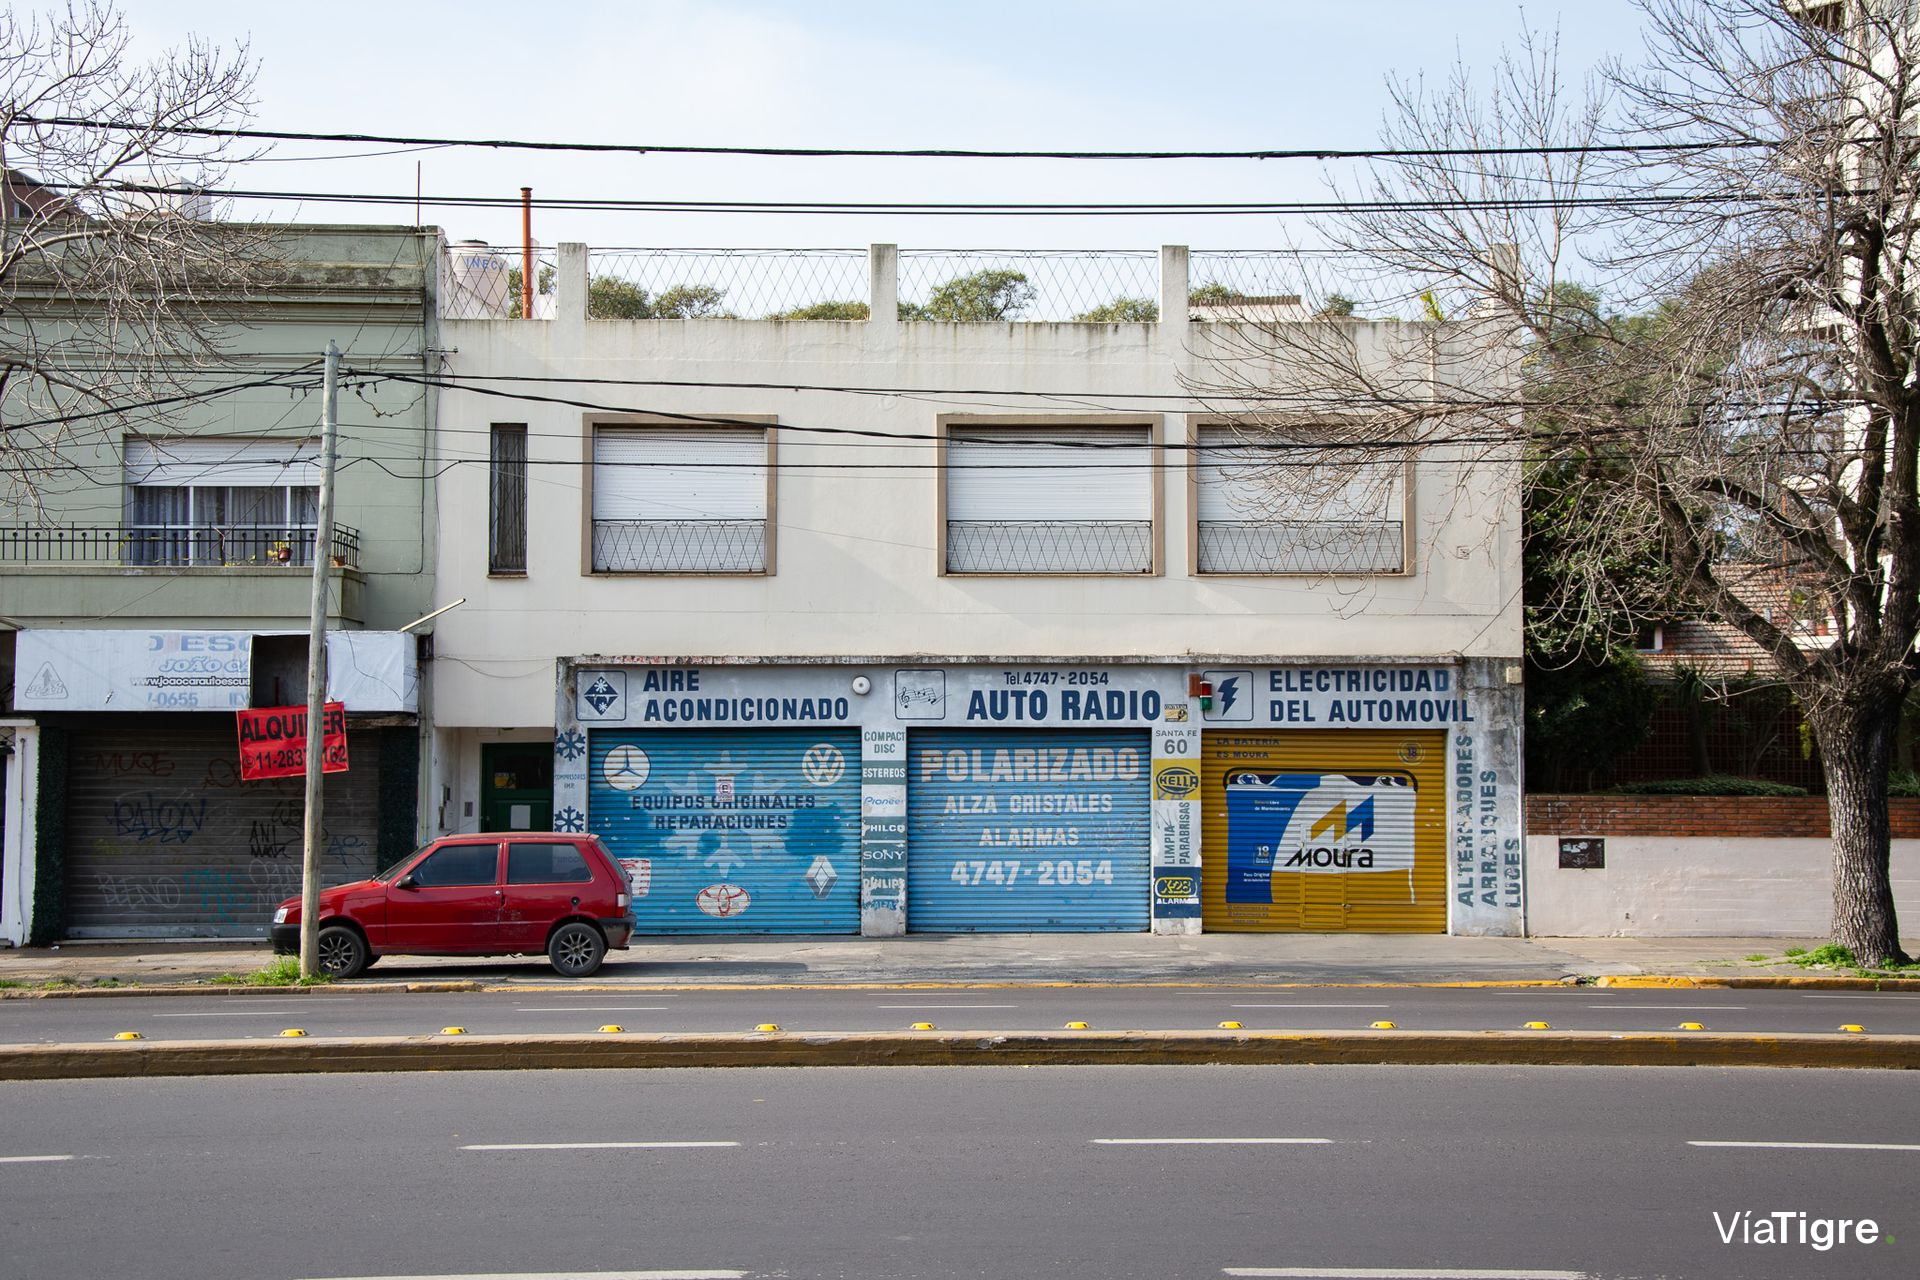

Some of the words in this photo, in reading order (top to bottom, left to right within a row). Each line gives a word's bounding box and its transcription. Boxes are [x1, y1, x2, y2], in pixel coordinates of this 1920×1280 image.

[643, 670, 699, 691] AIRE
[1269, 670, 1449, 692] ELECTRICIDAD
[644, 698, 849, 721] ACONDICIONADO
[967, 690, 1048, 721] AUTO
[1061, 690, 1161, 721] RADIO
[1270, 700, 1315, 722] DEL
[1329, 699, 1474, 722] AUTOMOVIL
[240, 710, 344, 742] ALQUIER
[864, 731, 905, 741] COMPACT
[874, 743, 895, 753] DISC
[1164, 739, 1188, 754] 60
[862, 768, 905, 778] ESTEREOS
[920, 748, 1139, 783] POLARIZADO
[1159, 775, 1199, 788] HELLA
[632, 796, 704, 810] EQUIPOS
[944, 795, 997, 814] ALZA
[1009, 794, 1112, 813] CRISTALES
[655, 815, 788, 829] REPARACIONES
[979, 827, 1079, 847] ALARMAS
[1179, 801, 1190, 864] PARABRISAS
[1164, 825, 1175, 864] LIMPIA
[863, 850, 905, 860] SONY
[1504, 838, 1522, 908] LUCES
